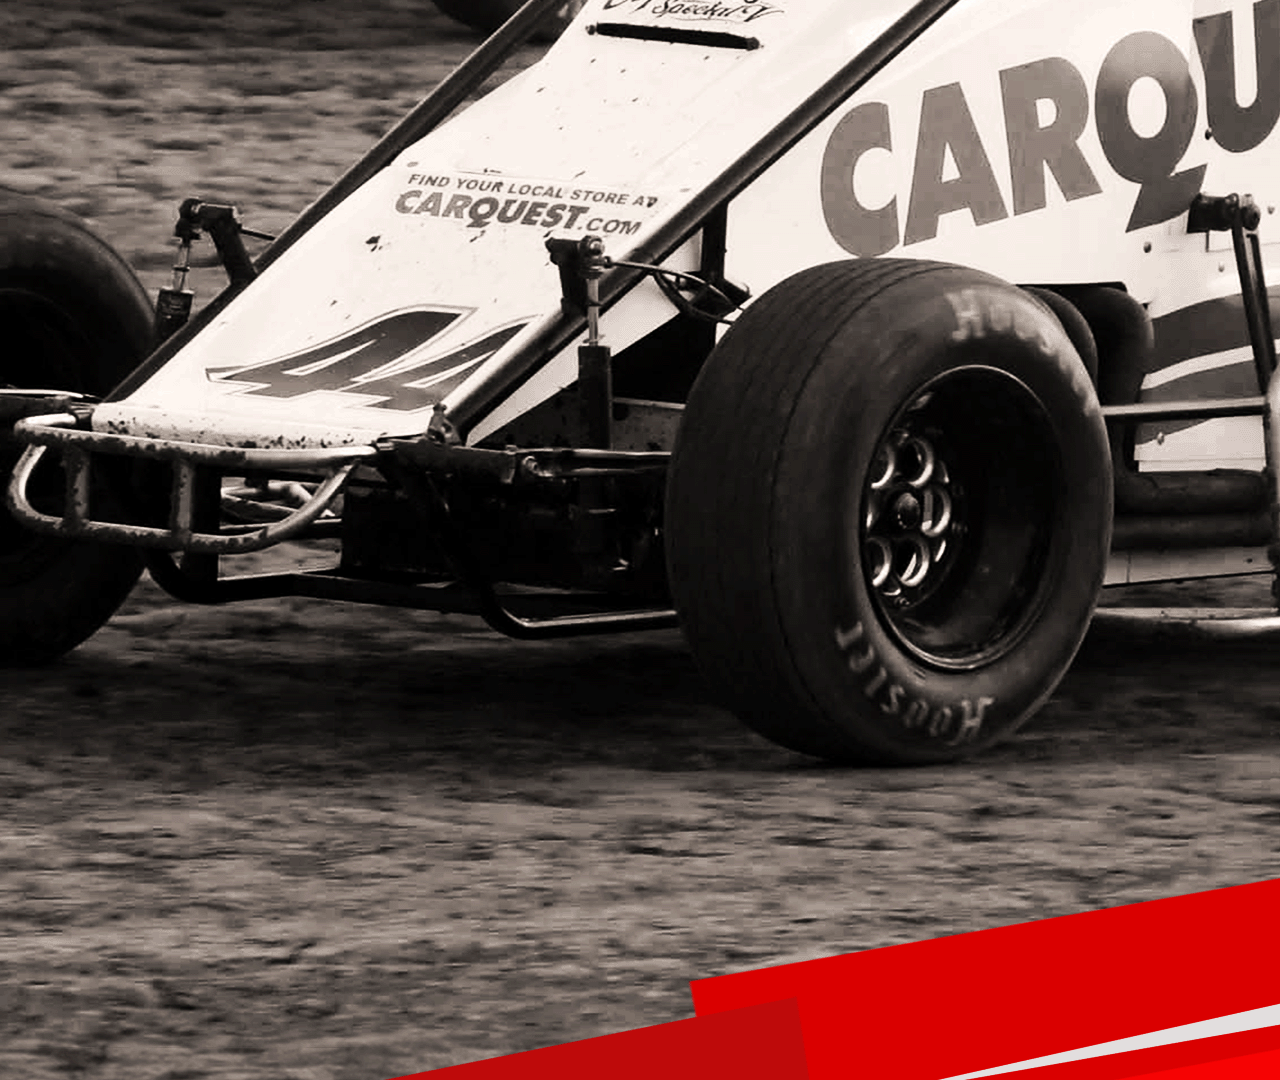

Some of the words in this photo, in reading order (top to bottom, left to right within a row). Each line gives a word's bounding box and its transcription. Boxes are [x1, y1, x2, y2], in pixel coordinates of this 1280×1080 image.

[407, 173, 451, 188] FIND
[456, 177, 504, 193] YOUR
[507, 183, 565, 199] LOCAL
[569, 189, 630, 206] STORE
[394, 189, 642, 235] CARQUEST.COM
